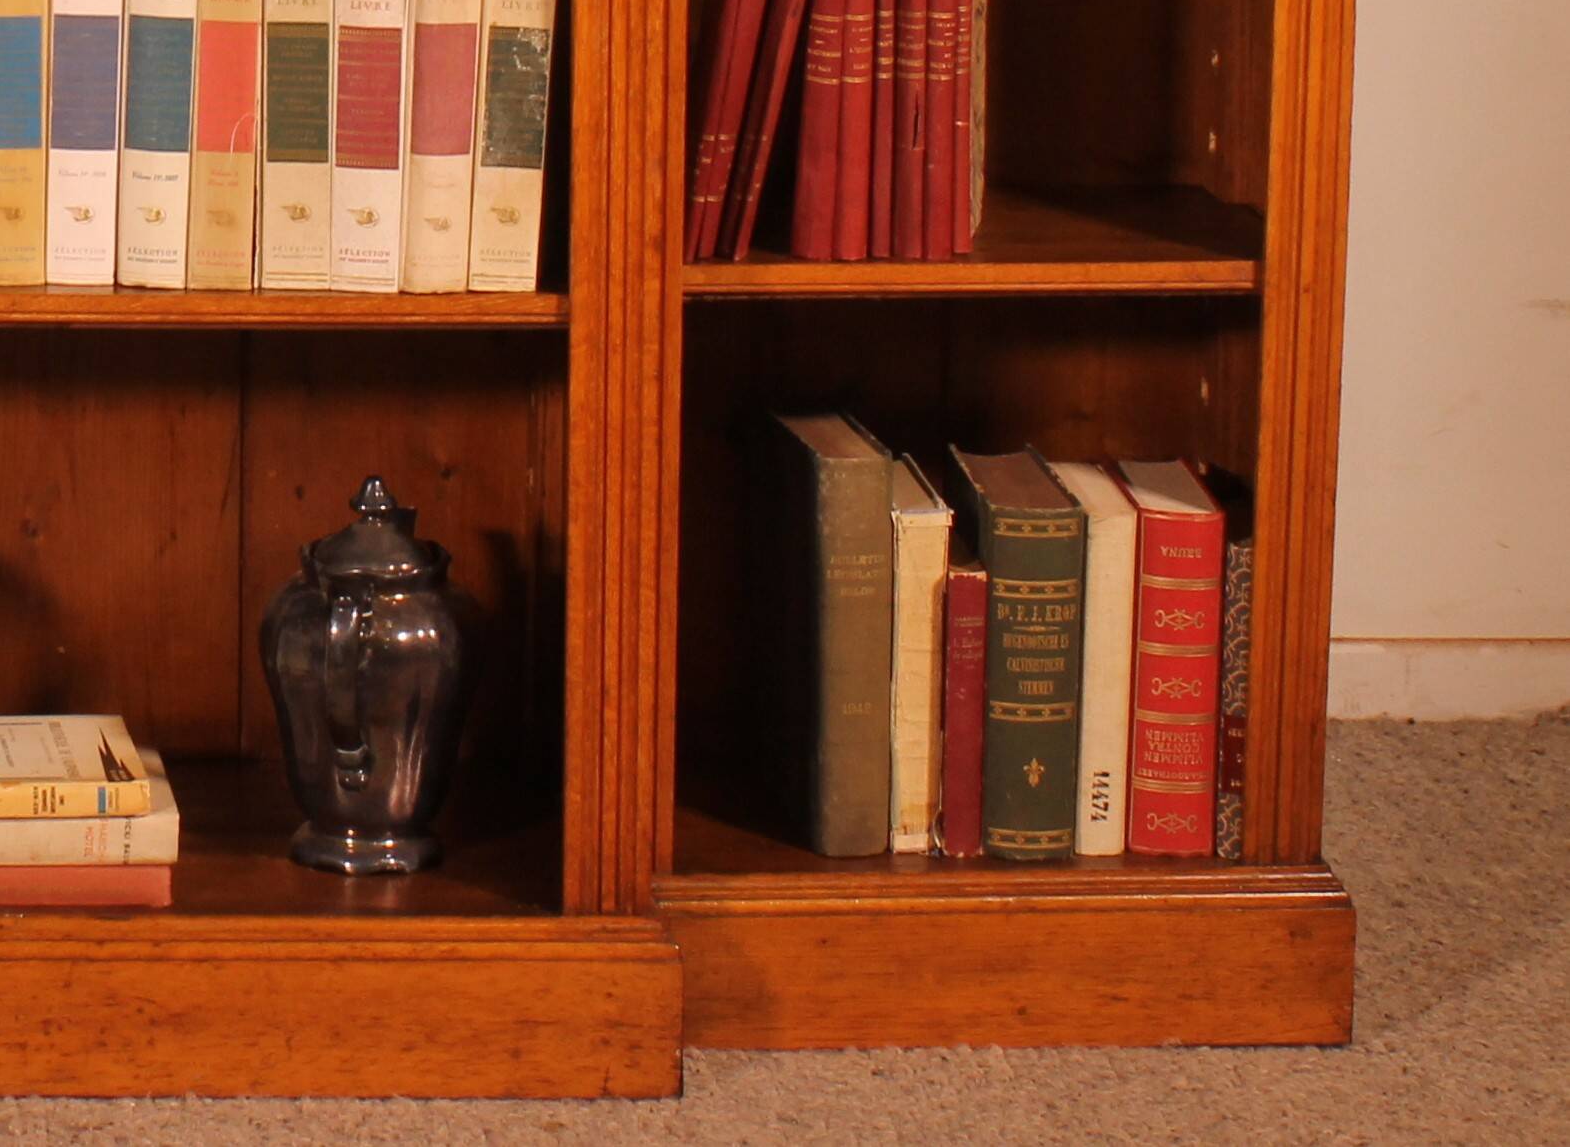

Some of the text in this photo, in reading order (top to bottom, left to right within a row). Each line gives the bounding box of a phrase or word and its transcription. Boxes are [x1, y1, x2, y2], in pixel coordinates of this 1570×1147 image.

[349, 1, 391, 11] LIVRE
[1159, 545, 1203, 559] BRUNA
[1044, 604, 1077, 622] KROP
[1144, 728, 1205, 742] VLIMMEN
[1147, 740, 1201, 753] CONTRA
[1143, 752, 1204, 765] VLIMMEN
[1090, 770, 1111, 823] 14474
